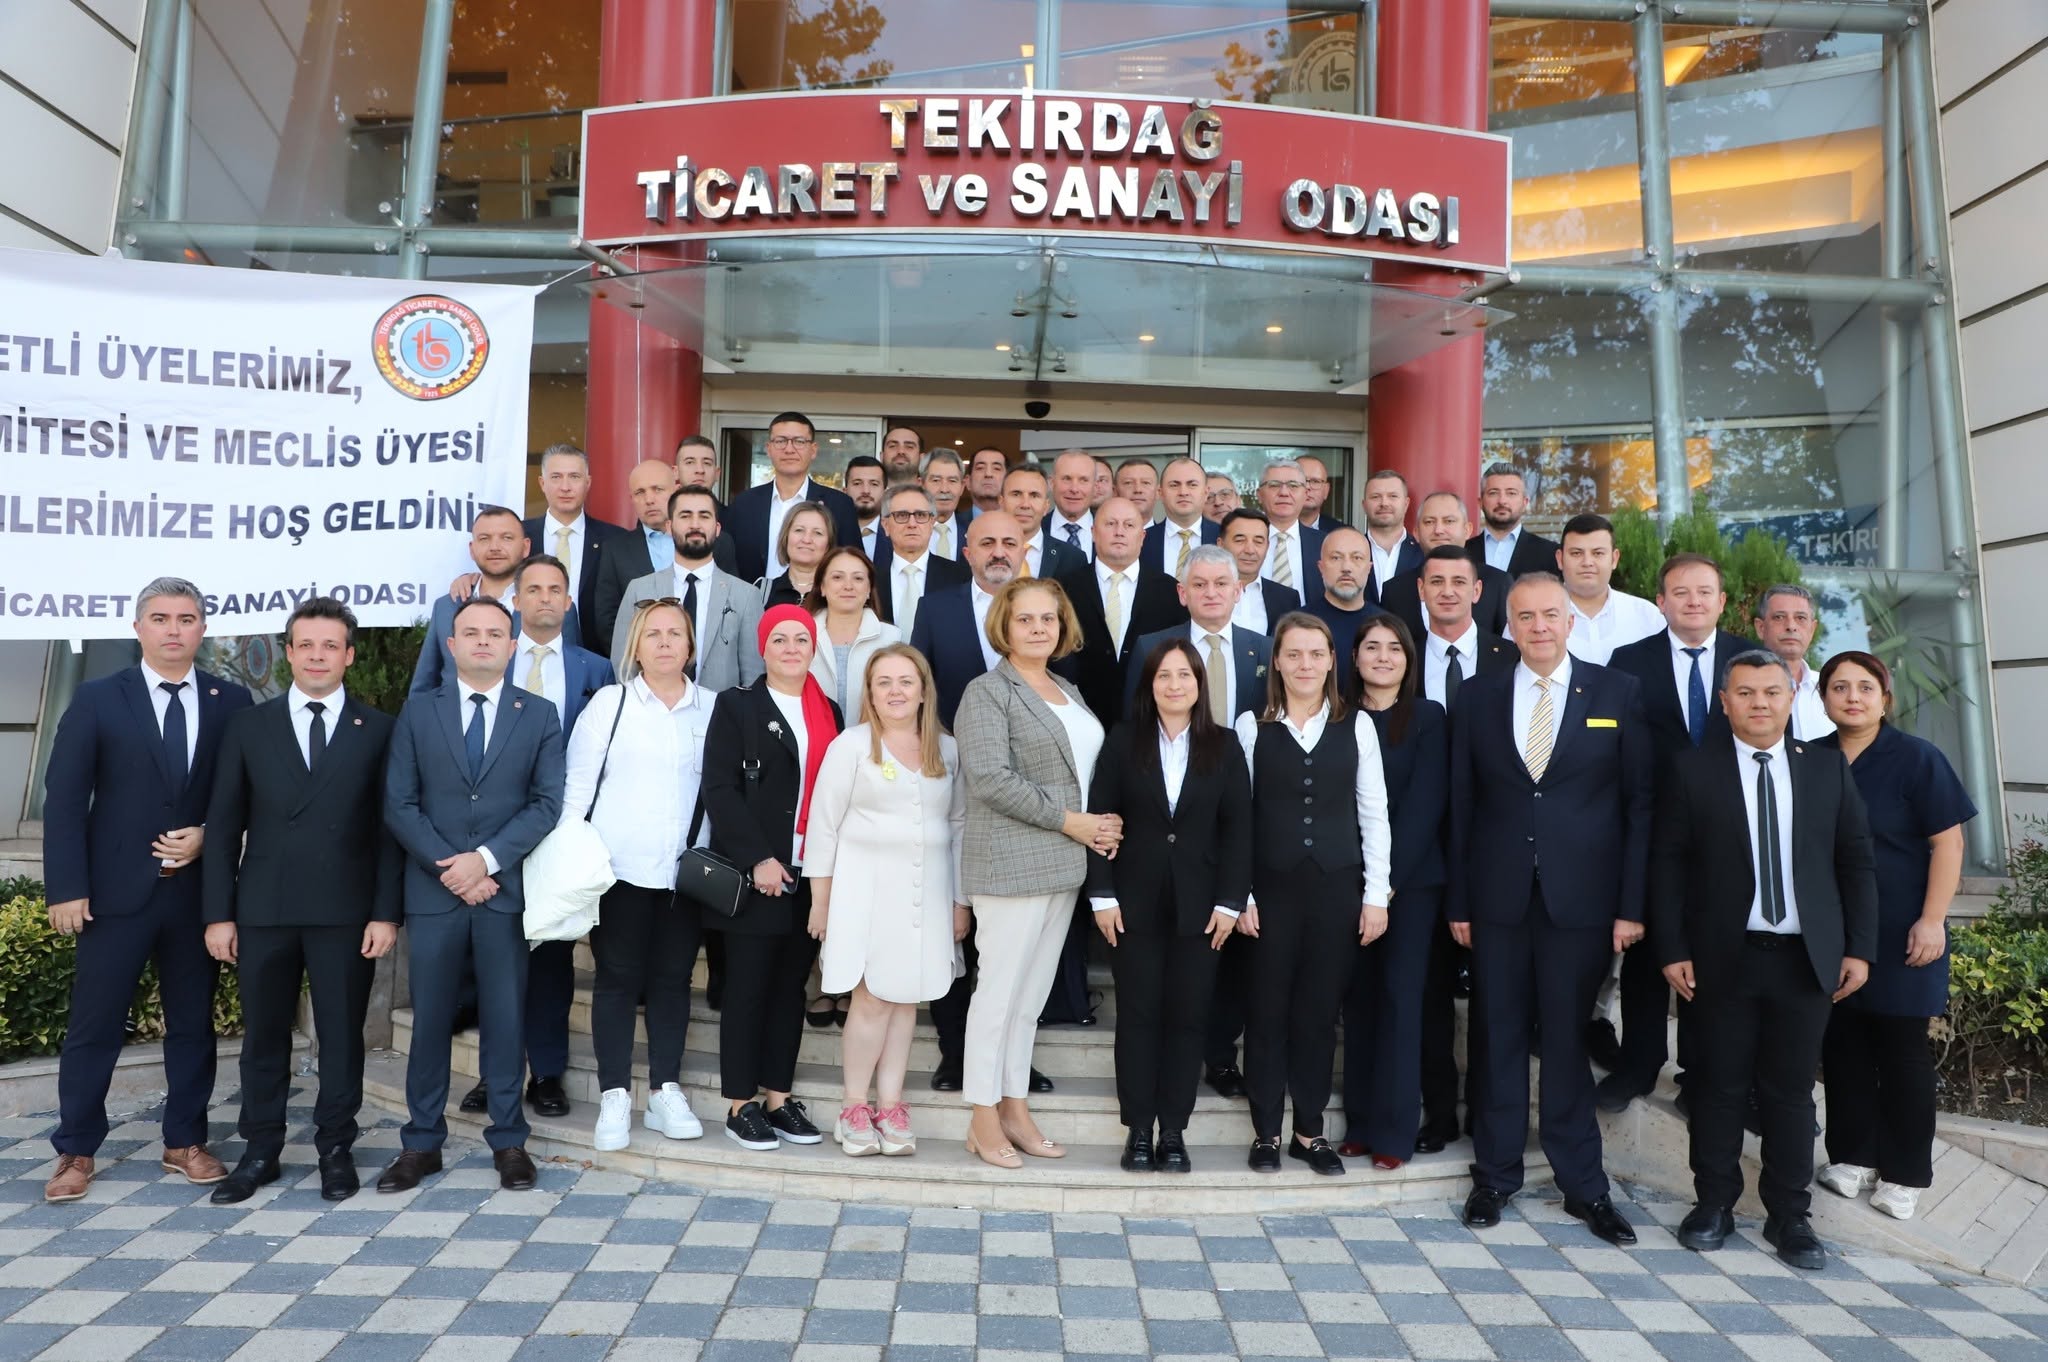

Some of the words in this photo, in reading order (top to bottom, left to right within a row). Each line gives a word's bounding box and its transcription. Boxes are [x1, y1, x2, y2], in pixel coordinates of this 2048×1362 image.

[879, 86, 1223, 161] TEKİRDAĞ
[637, 155, 898, 222] TİCARET
[918, 173, 989, 216] ve
[1010, 160, 1243, 226] SANAYİ
[1281, 178, 1459, 248] ODASI
[98, 335, 362, 405] ÜYELERİMİZ,
[144, 424, 198, 462] VE
[215, 425, 361, 467] MECLİS
[376, 421, 485, 466] ÜYESİ
[0, 490, 213, 539] LERİMİZE
[229, 504, 310, 546] HOŞ
[323, 489, 497, 533] GELDİNİ
[329, 583, 427, 606] ODASI
